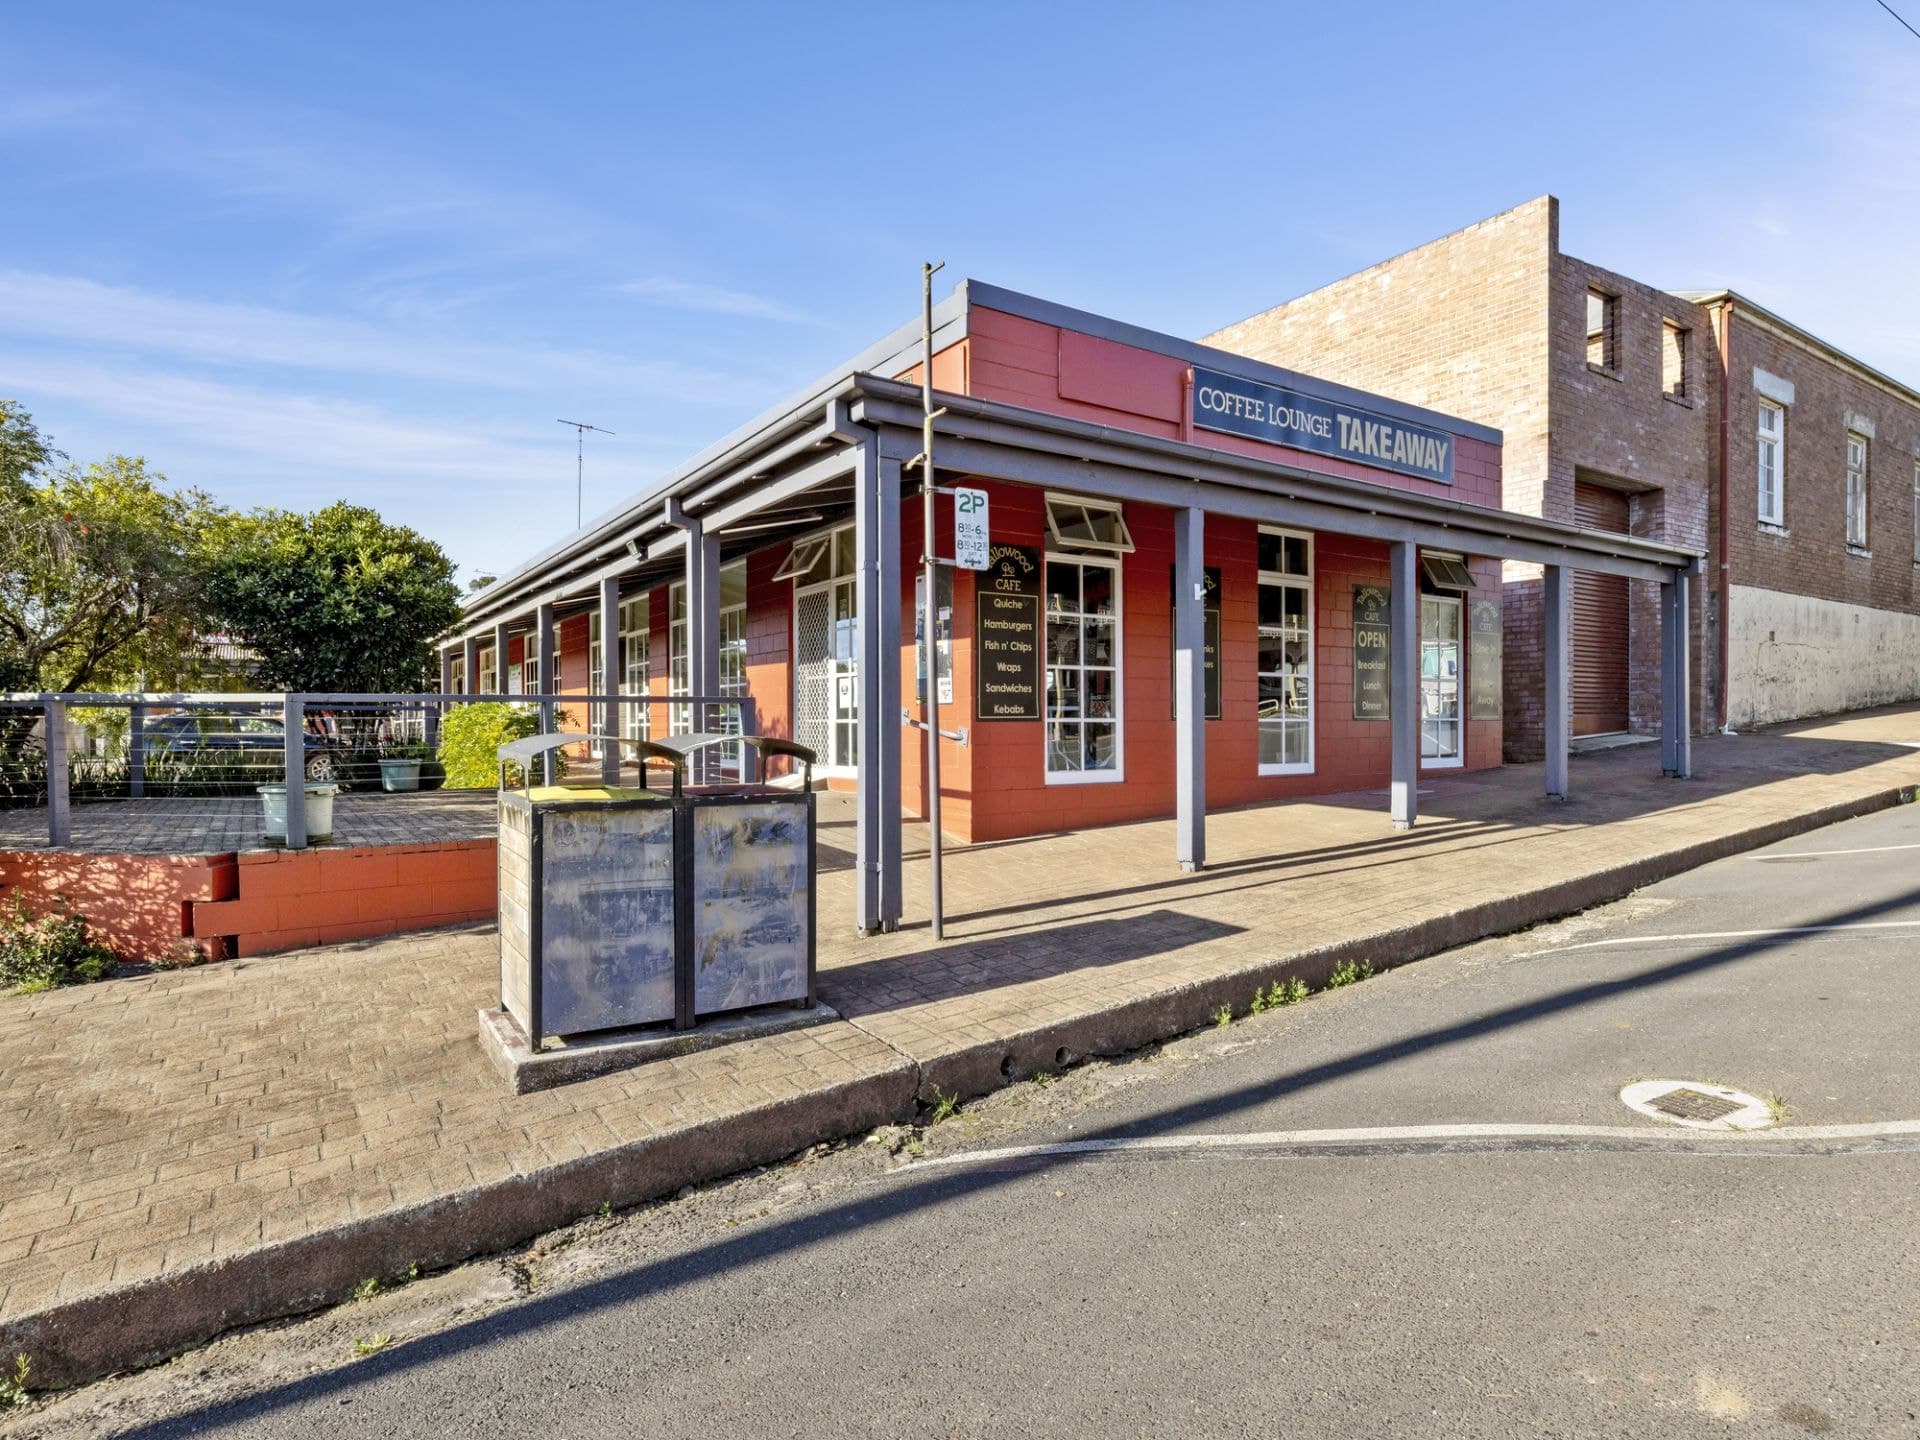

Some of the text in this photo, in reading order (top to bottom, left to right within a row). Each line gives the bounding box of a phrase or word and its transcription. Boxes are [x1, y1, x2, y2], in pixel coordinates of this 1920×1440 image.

[1199, 386, 1448, 472] COFFEE LOUNGE TAKEAWAY
[959, 493, 985, 513] 2P
[990, 547, 1035, 573] allowood
[995, 579, 1022, 591] CAFE
[993, 598, 1024, 609] Quiche
[984, 619, 1032, 632] Hamburgers
[1358, 631, 1386, 648] OPEN
[984, 640, 1000, 650] Fish
[1010, 641, 1032, 653] Chips
[996, 662, 1022, 673] Wraps
[1357, 660, 1386, 670] Breakfast
[985, 683, 1032, 693] Sandwiches
[1363, 680, 1382, 690] Lunch
[993, 704, 1025, 714] Kebabs
[1362, 701, 1382, 711] Dinner
